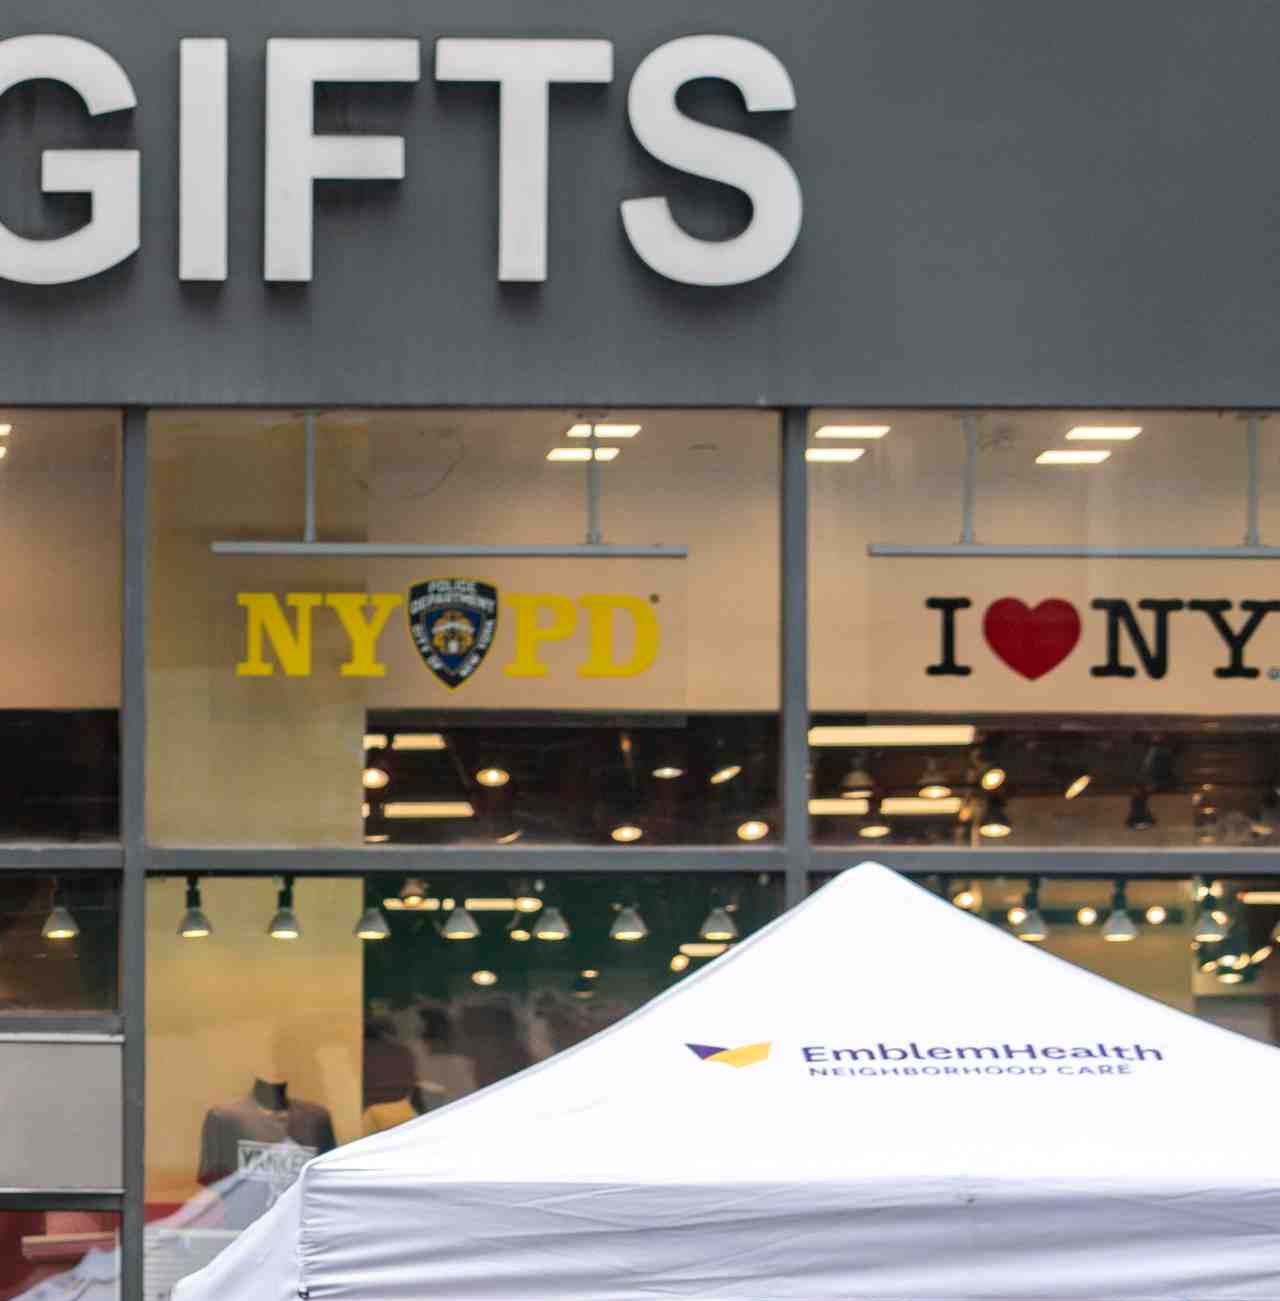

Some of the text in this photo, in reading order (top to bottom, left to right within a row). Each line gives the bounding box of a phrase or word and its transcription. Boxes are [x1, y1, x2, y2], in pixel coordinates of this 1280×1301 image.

[925, 597, 1280, 680] I NY
[802, 1042, 1164, 1064] EmblemHealth
[807, 1063, 1136, 1078] NEIGHBORHOOD CARE
